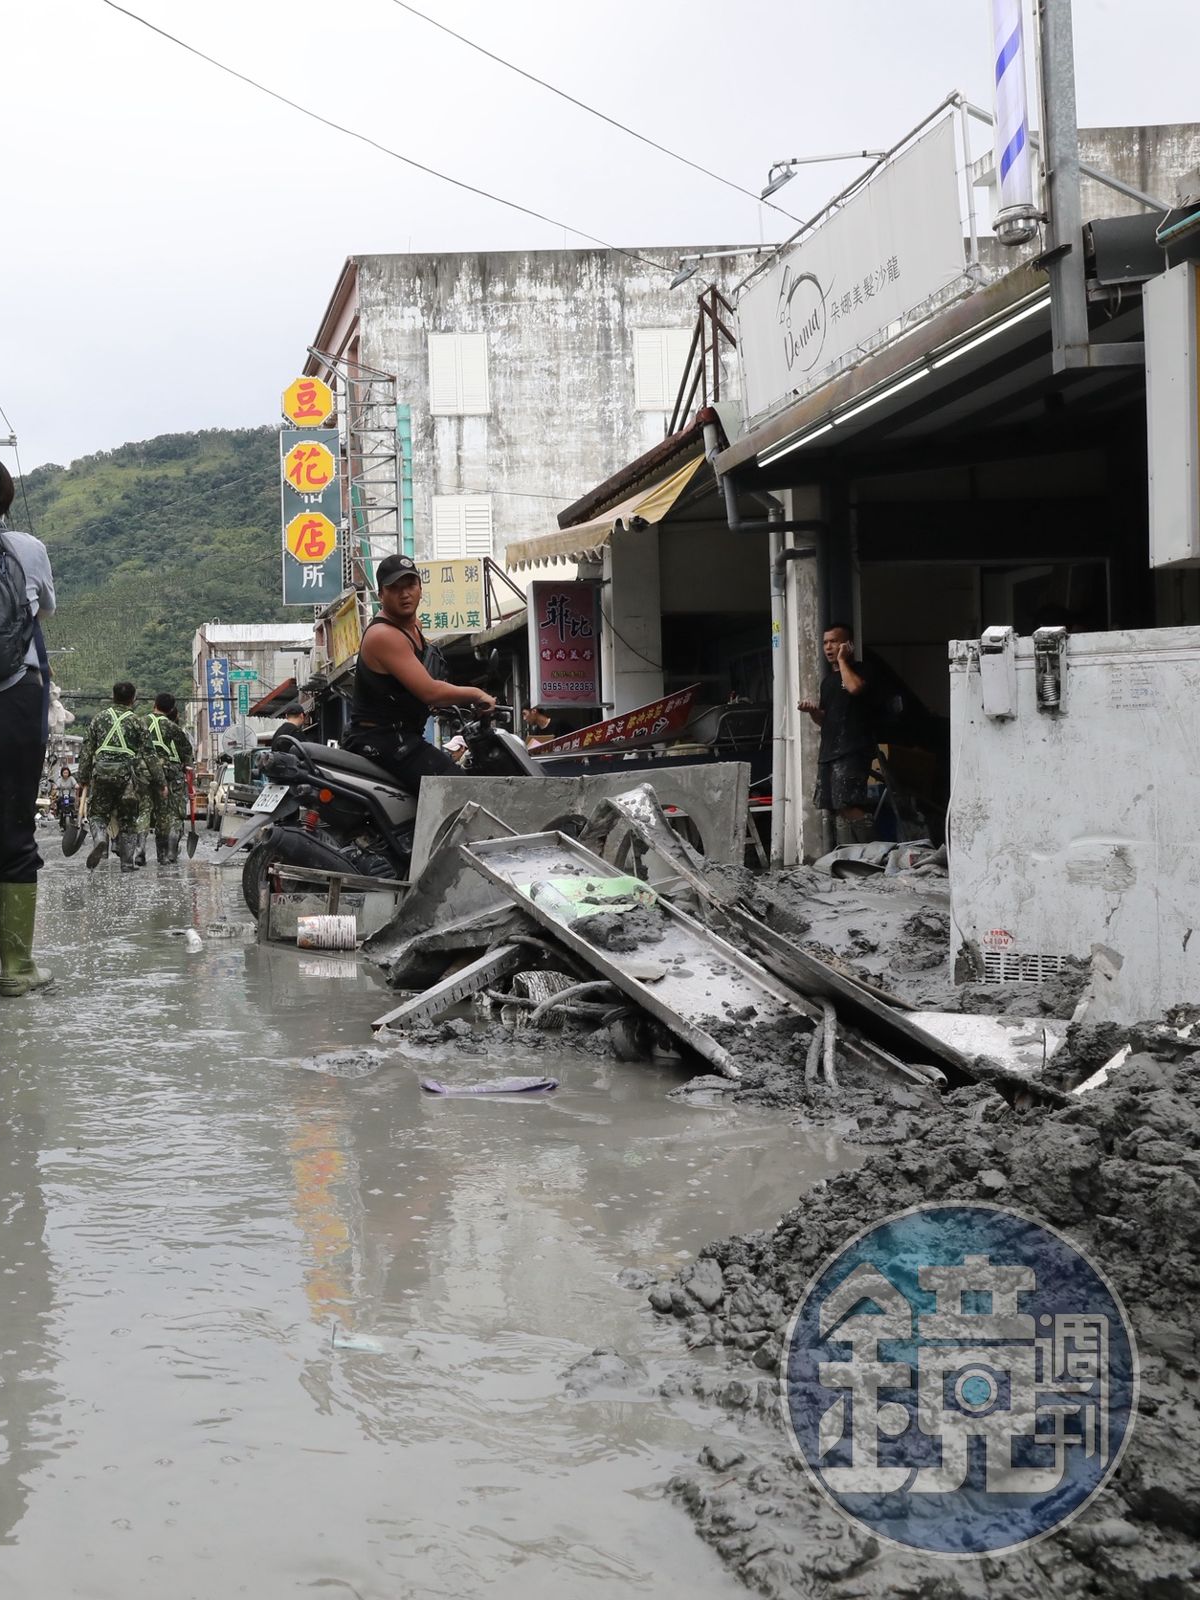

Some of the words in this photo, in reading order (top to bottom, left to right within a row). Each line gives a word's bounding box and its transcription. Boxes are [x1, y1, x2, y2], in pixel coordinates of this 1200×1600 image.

[830, 255, 901, 325] 朵娜美髮沙龍
[291, 382, 328, 557] 豆花店
[418, 565, 479, 584] 地瓜粥
[419, 611, 481, 629] 各類小菜
[540, 594, 594, 642] 菲比
